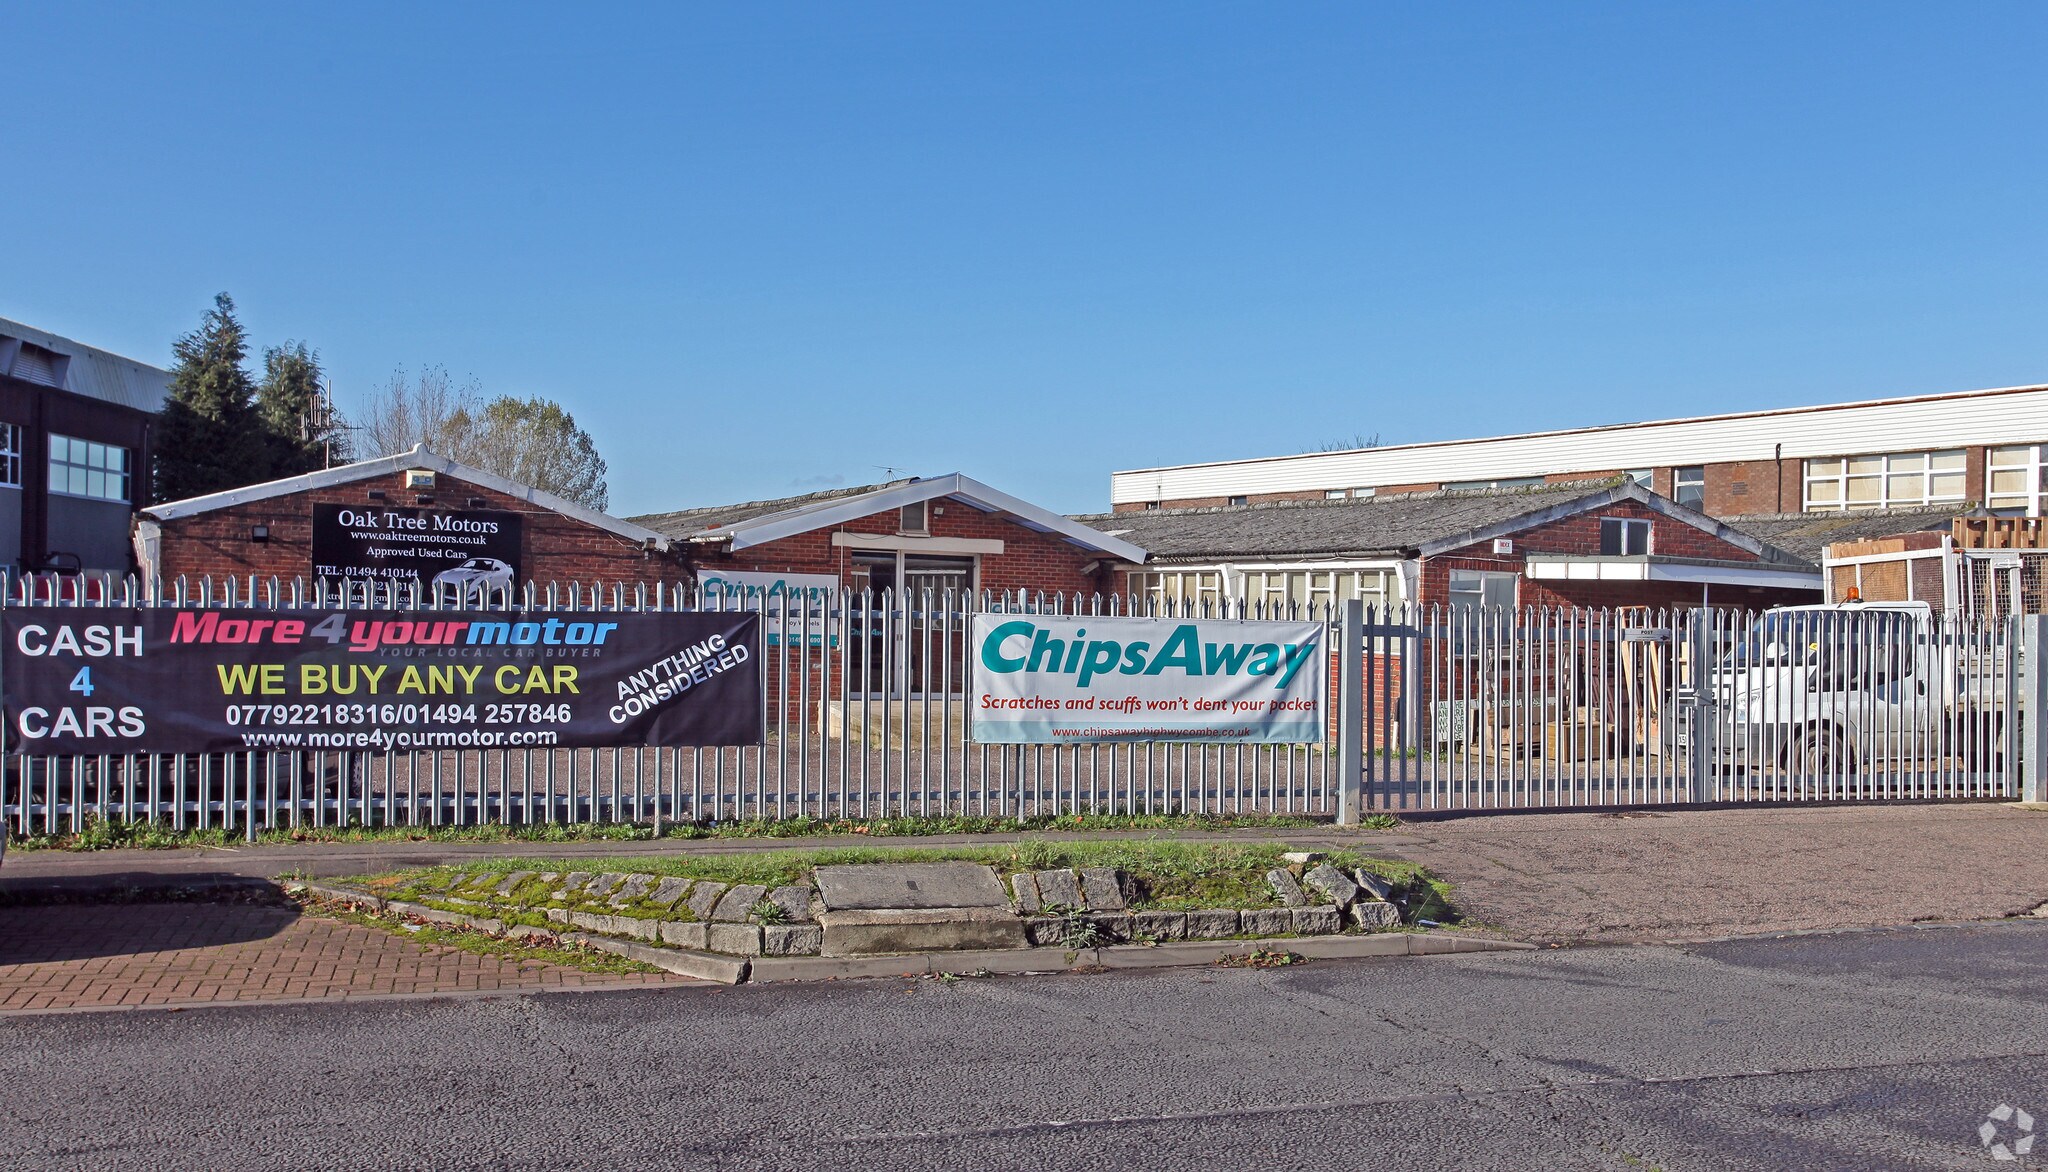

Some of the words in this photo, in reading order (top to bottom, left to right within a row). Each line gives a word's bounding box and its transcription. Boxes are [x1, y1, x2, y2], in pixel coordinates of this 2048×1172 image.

[338, 510, 378, 528] Oak
[384, 512, 427, 530] Tree
[433, 515, 498, 533] Motors
[350, 531, 487, 545] www.oaktreemotors.co.uk
[366, 546, 415, 557] Approved
[418, 548, 442, 558] Used
[445, 549, 467, 559] Cars
[316, 565, 343, 576] TEL:
[345, 566, 378, 577] 01494
[380, 567, 418, 578] 410144
[17, 624, 143, 656] CASH
[379, 648, 427, 657] YOUR
[437, 648, 493, 657] LOCAL
[503, 648, 535, 657] CAR
[546, 648, 601, 657] BUYER
[982, 620, 1316, 689] ChipsAway
[615, 633, 726, 700] ANYTHING
[70, 666, 94, 696] 4
[217, 664, 286, 695] WE
[301, 664, 387, 695] BUY
[397, 665, 483, 694] ANY
[495, 665, 580, 694] CAR
[609, 644, 750, 724] CONSIDERED
[226, 703, 477, 725] 07792218316/01494
[485, 703, 572, 723] 257846
[981, 694, 1060, 710] Scratches
[1065, 696, 1095, 710] and
[1099, 695, 1141, 713] scuffs
[1147, 697, 1188, 711] won't
[1193, 697, 1227, 711] dent
[1232, 700, 1265, 714] your
[1270, 697, 1317, 712] pocket
[19, 706, 146, 738] CARS
[1052, 726, 1250, 738] www.chipsawayhighwycombe.co.uk
[241, 729, 558, 750] www.more4yourmotor.com
